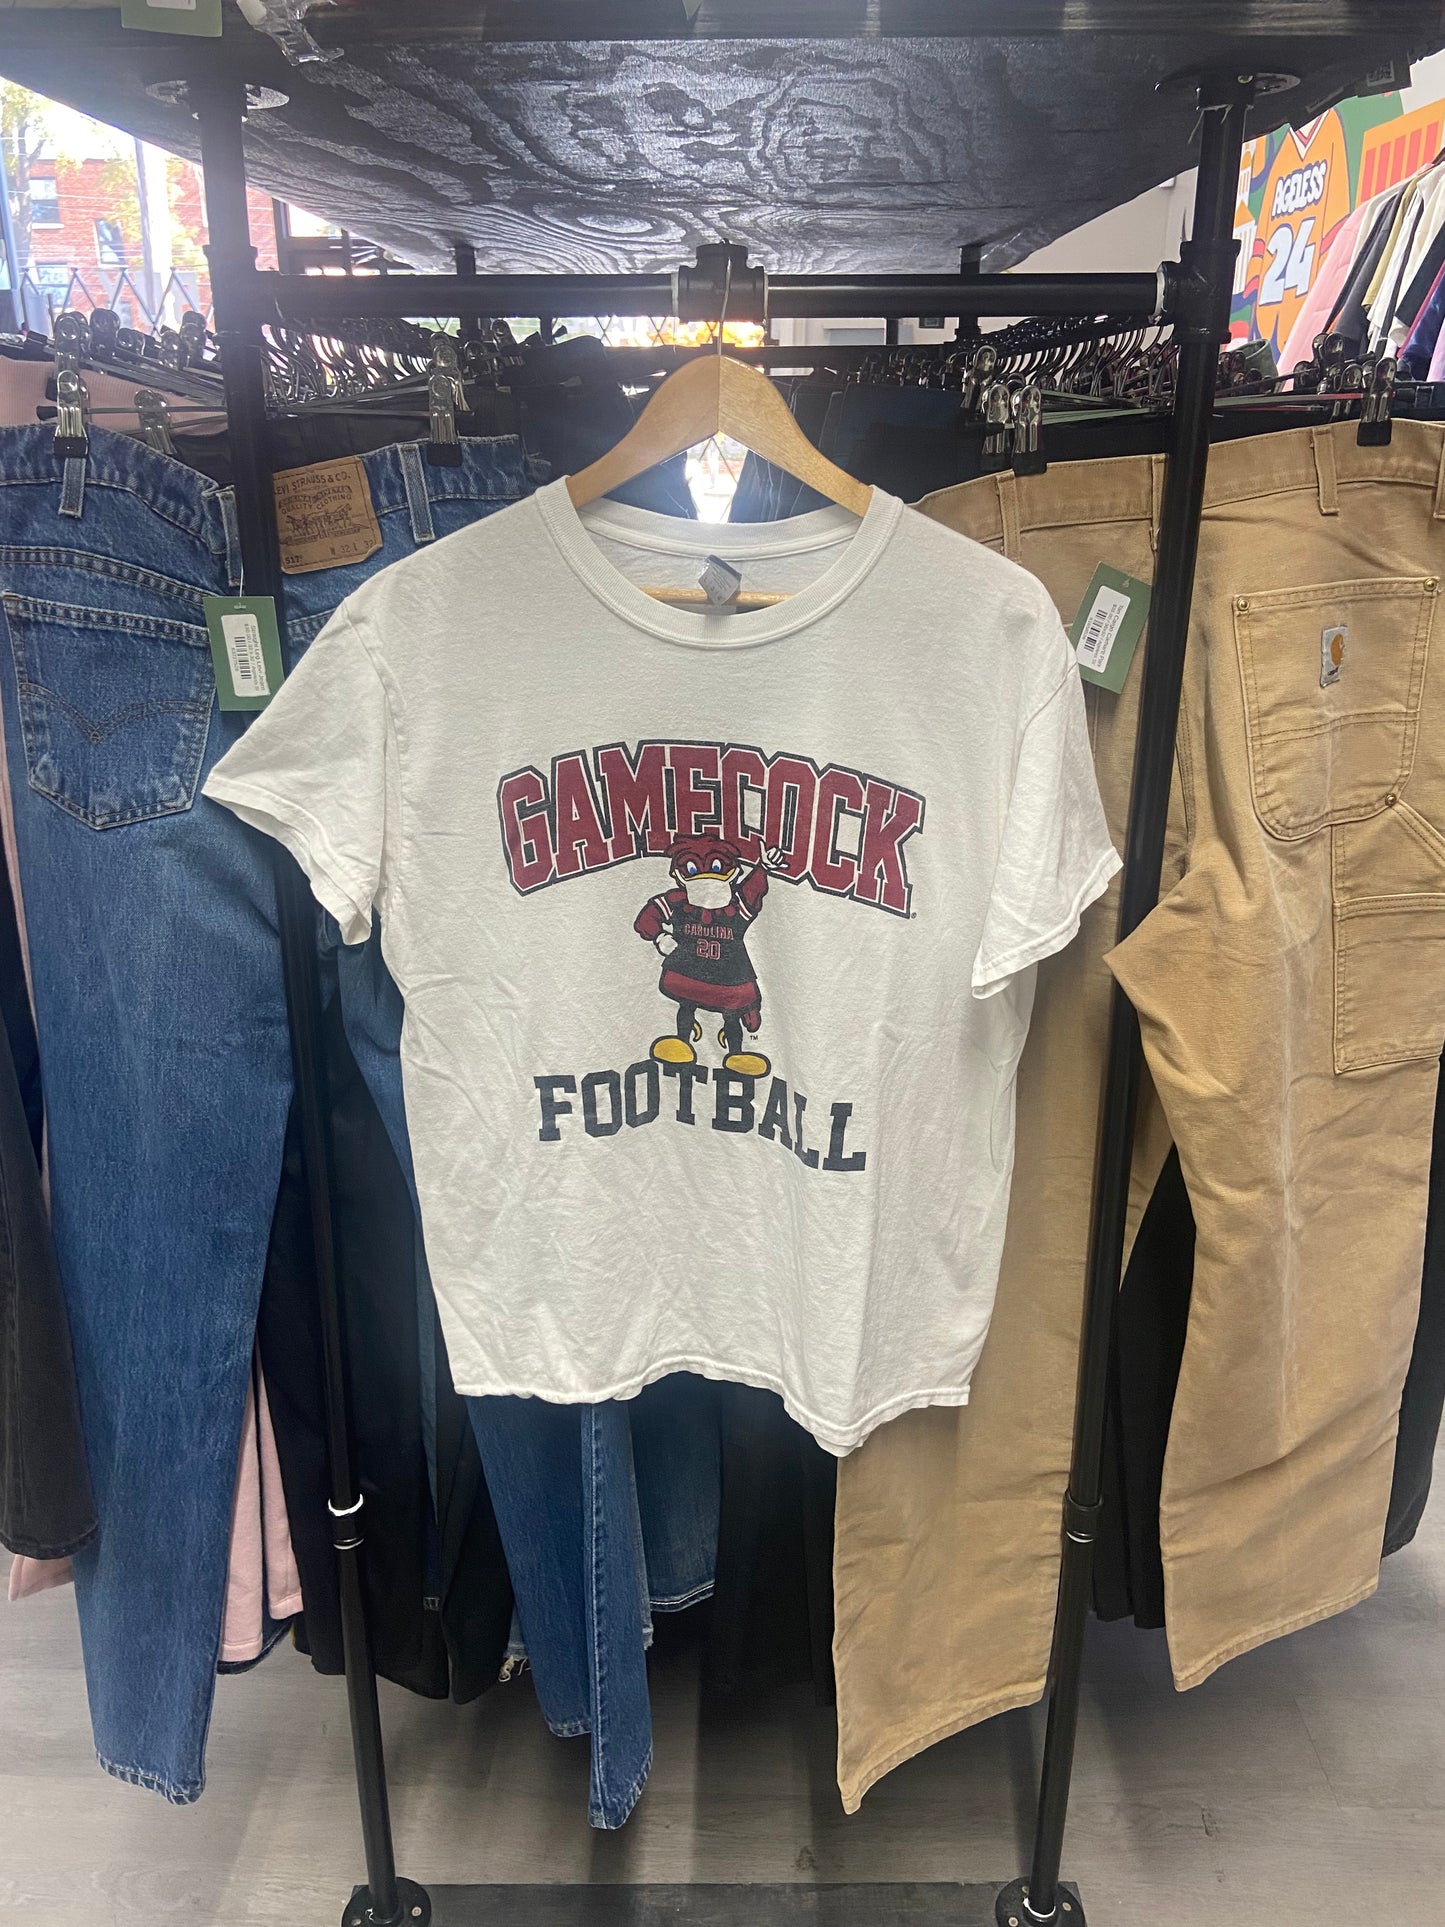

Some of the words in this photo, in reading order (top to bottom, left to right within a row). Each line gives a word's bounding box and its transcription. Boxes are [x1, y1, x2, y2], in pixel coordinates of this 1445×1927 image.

[1271, 161, 1328, 218] AGELESS
[1259, 217, 1316, 305] 24
[281, 503, 313, 515] QUALITY
[497, 739, 926, 919] GAMECOCK
[684, 923, 734, 940] CAROLINA
[696, 938, 721, 960] 20
[533, 1060, 866, 1172] FOOTBALL
